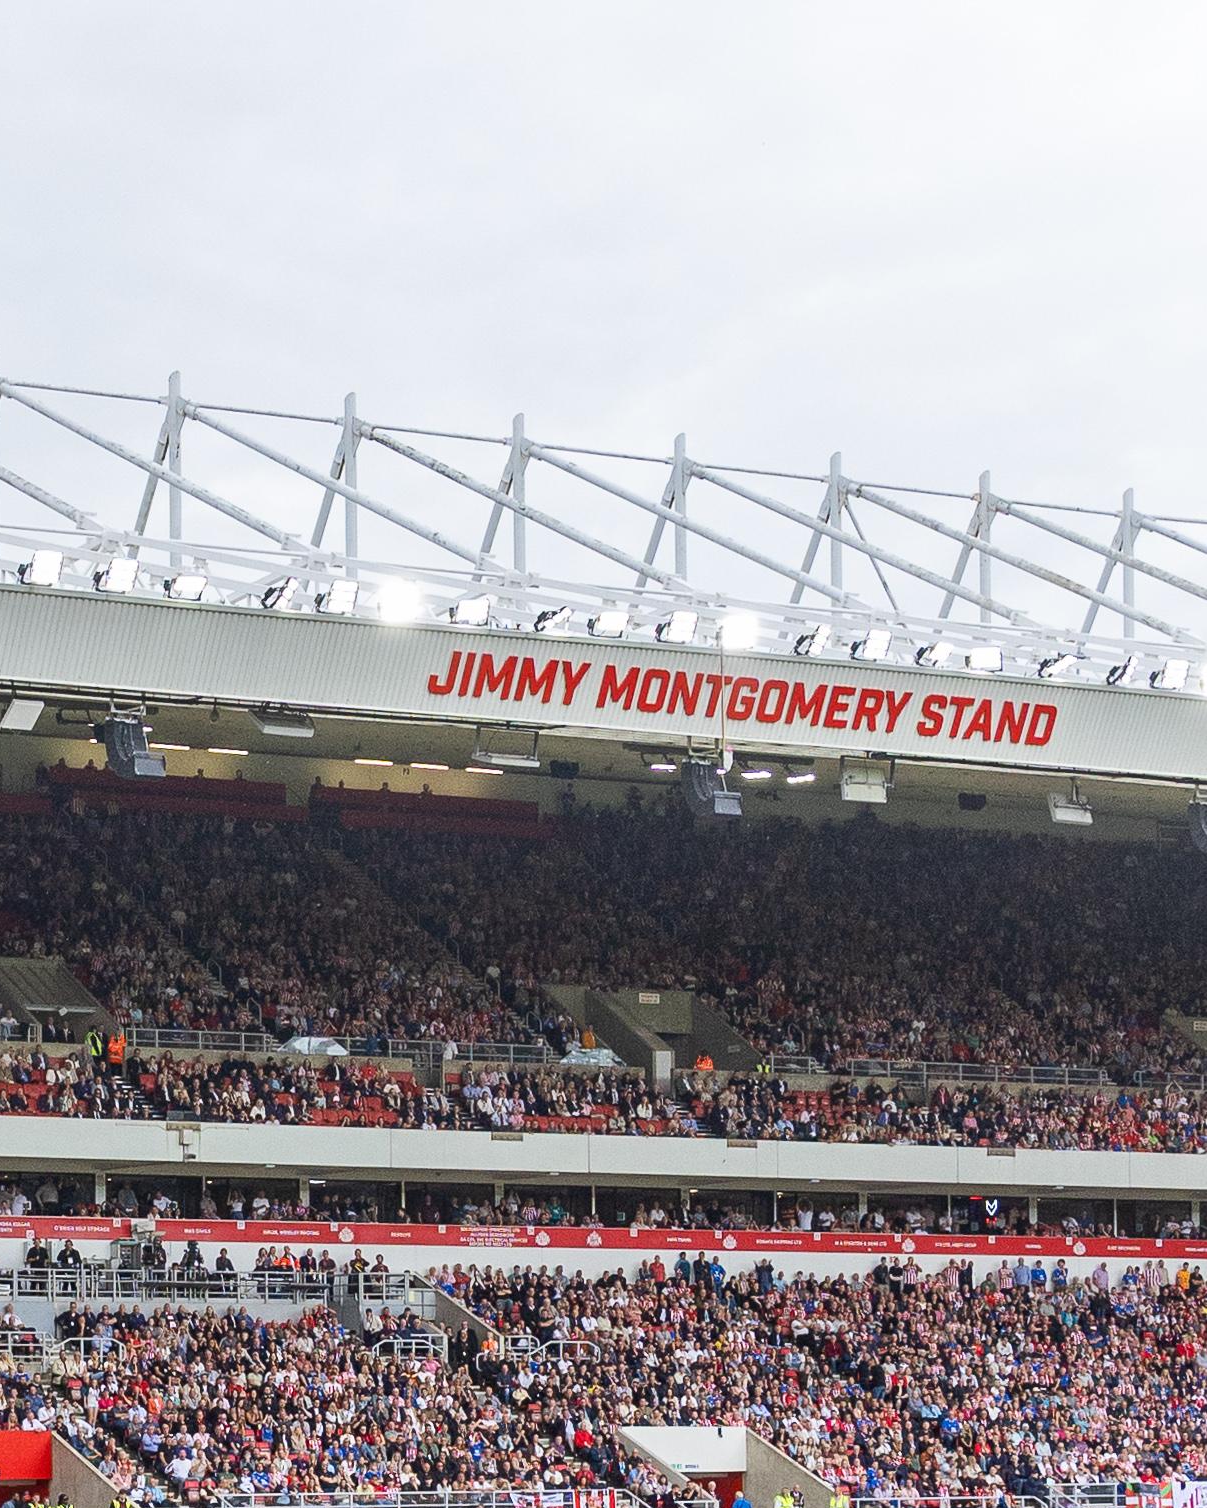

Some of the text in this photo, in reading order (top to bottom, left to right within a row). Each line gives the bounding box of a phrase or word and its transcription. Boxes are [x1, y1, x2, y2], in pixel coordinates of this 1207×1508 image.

[428, 651, 1058, 746] JIMMY MONTGOMERY STAND
